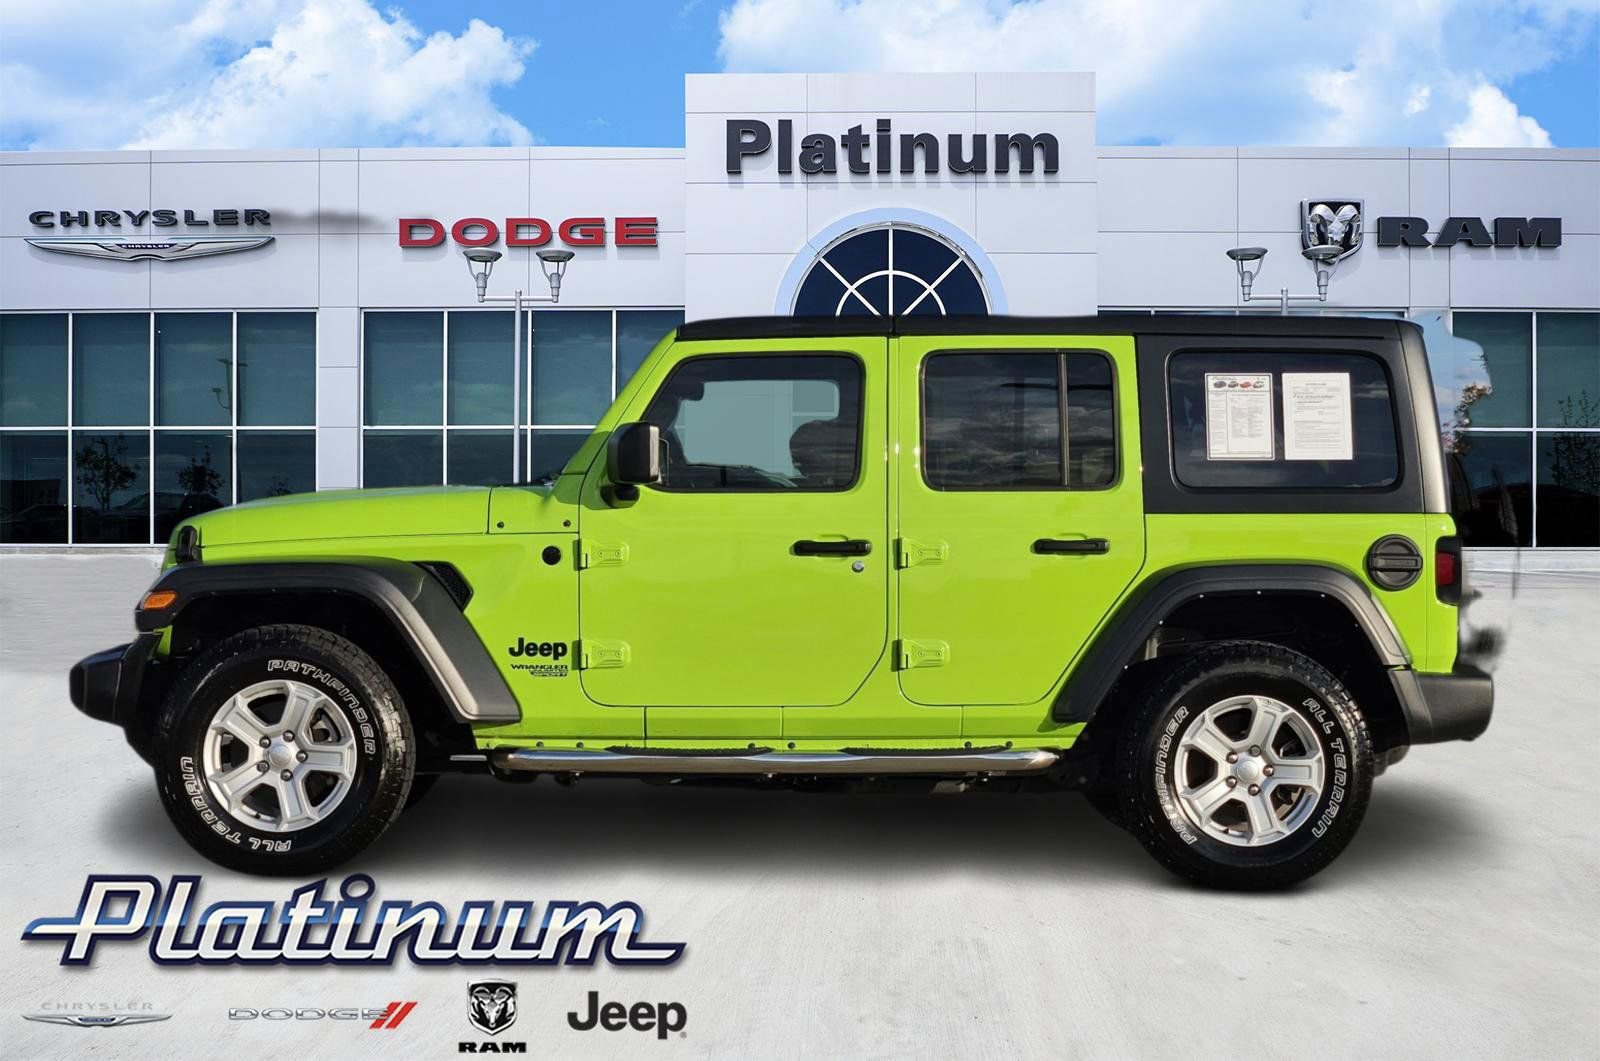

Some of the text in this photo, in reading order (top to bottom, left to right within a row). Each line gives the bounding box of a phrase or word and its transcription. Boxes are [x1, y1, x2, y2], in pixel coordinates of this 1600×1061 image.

[726, 118, 1060, 174] Platinum
[28, 209, 272, 227] CHRYSLER
[399, 217, 659, 248] DODGE
[1377, 217, 1562, 248] RAM
[508, 637, 567, 660] Jeep
[267, 659, 376, 755] PATHFINDER
[1303, 698, 1347, 839] ALL TERRAIN
[179, 756, 292, 852] ALL TERRAIN
